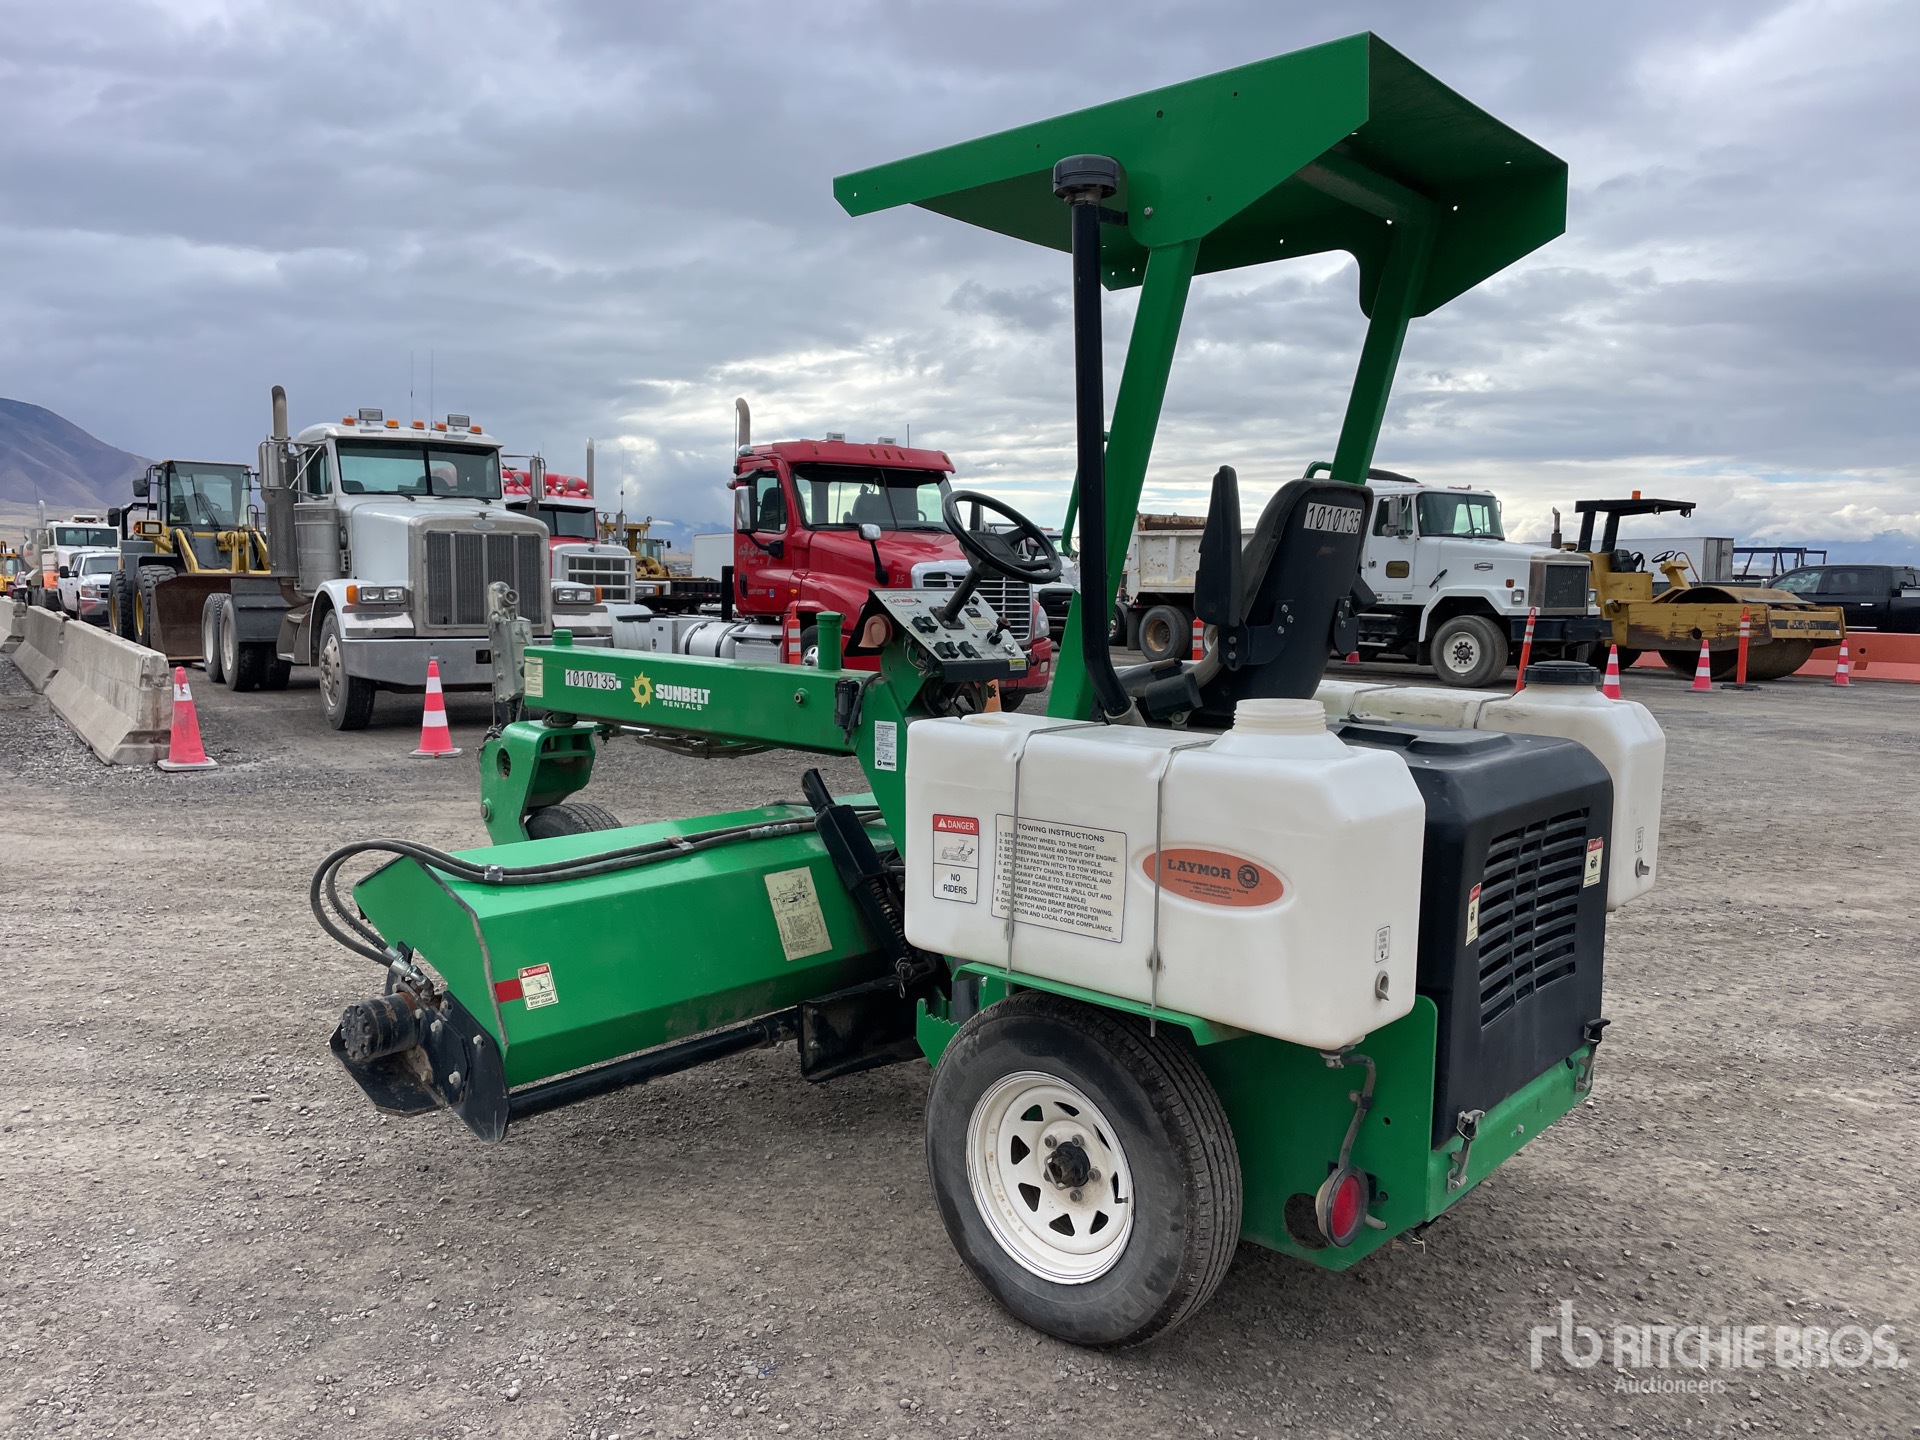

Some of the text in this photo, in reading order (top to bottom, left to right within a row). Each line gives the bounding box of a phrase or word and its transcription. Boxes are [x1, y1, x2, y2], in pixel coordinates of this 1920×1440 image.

[1308, 504, 1360, 532] 1010135
[566, 670, 615, 690] 1010135
[656, 684, 710, 704] SUNBELT
[662, 700, 702, 710] RENTALS
[948, 820, 974, 830] DANGER
[1017, 823, 1105, 842] TOWING INSTRUCTIONS
[1168, 859, 1231, 880] LAYMOR
[950, 873, 960, 882] NO
[943, 884, 967, 894] RIDERS
[1002, 890, 1023, 899] RELASE
[1000, 905, 1028, 915] OPEATION
